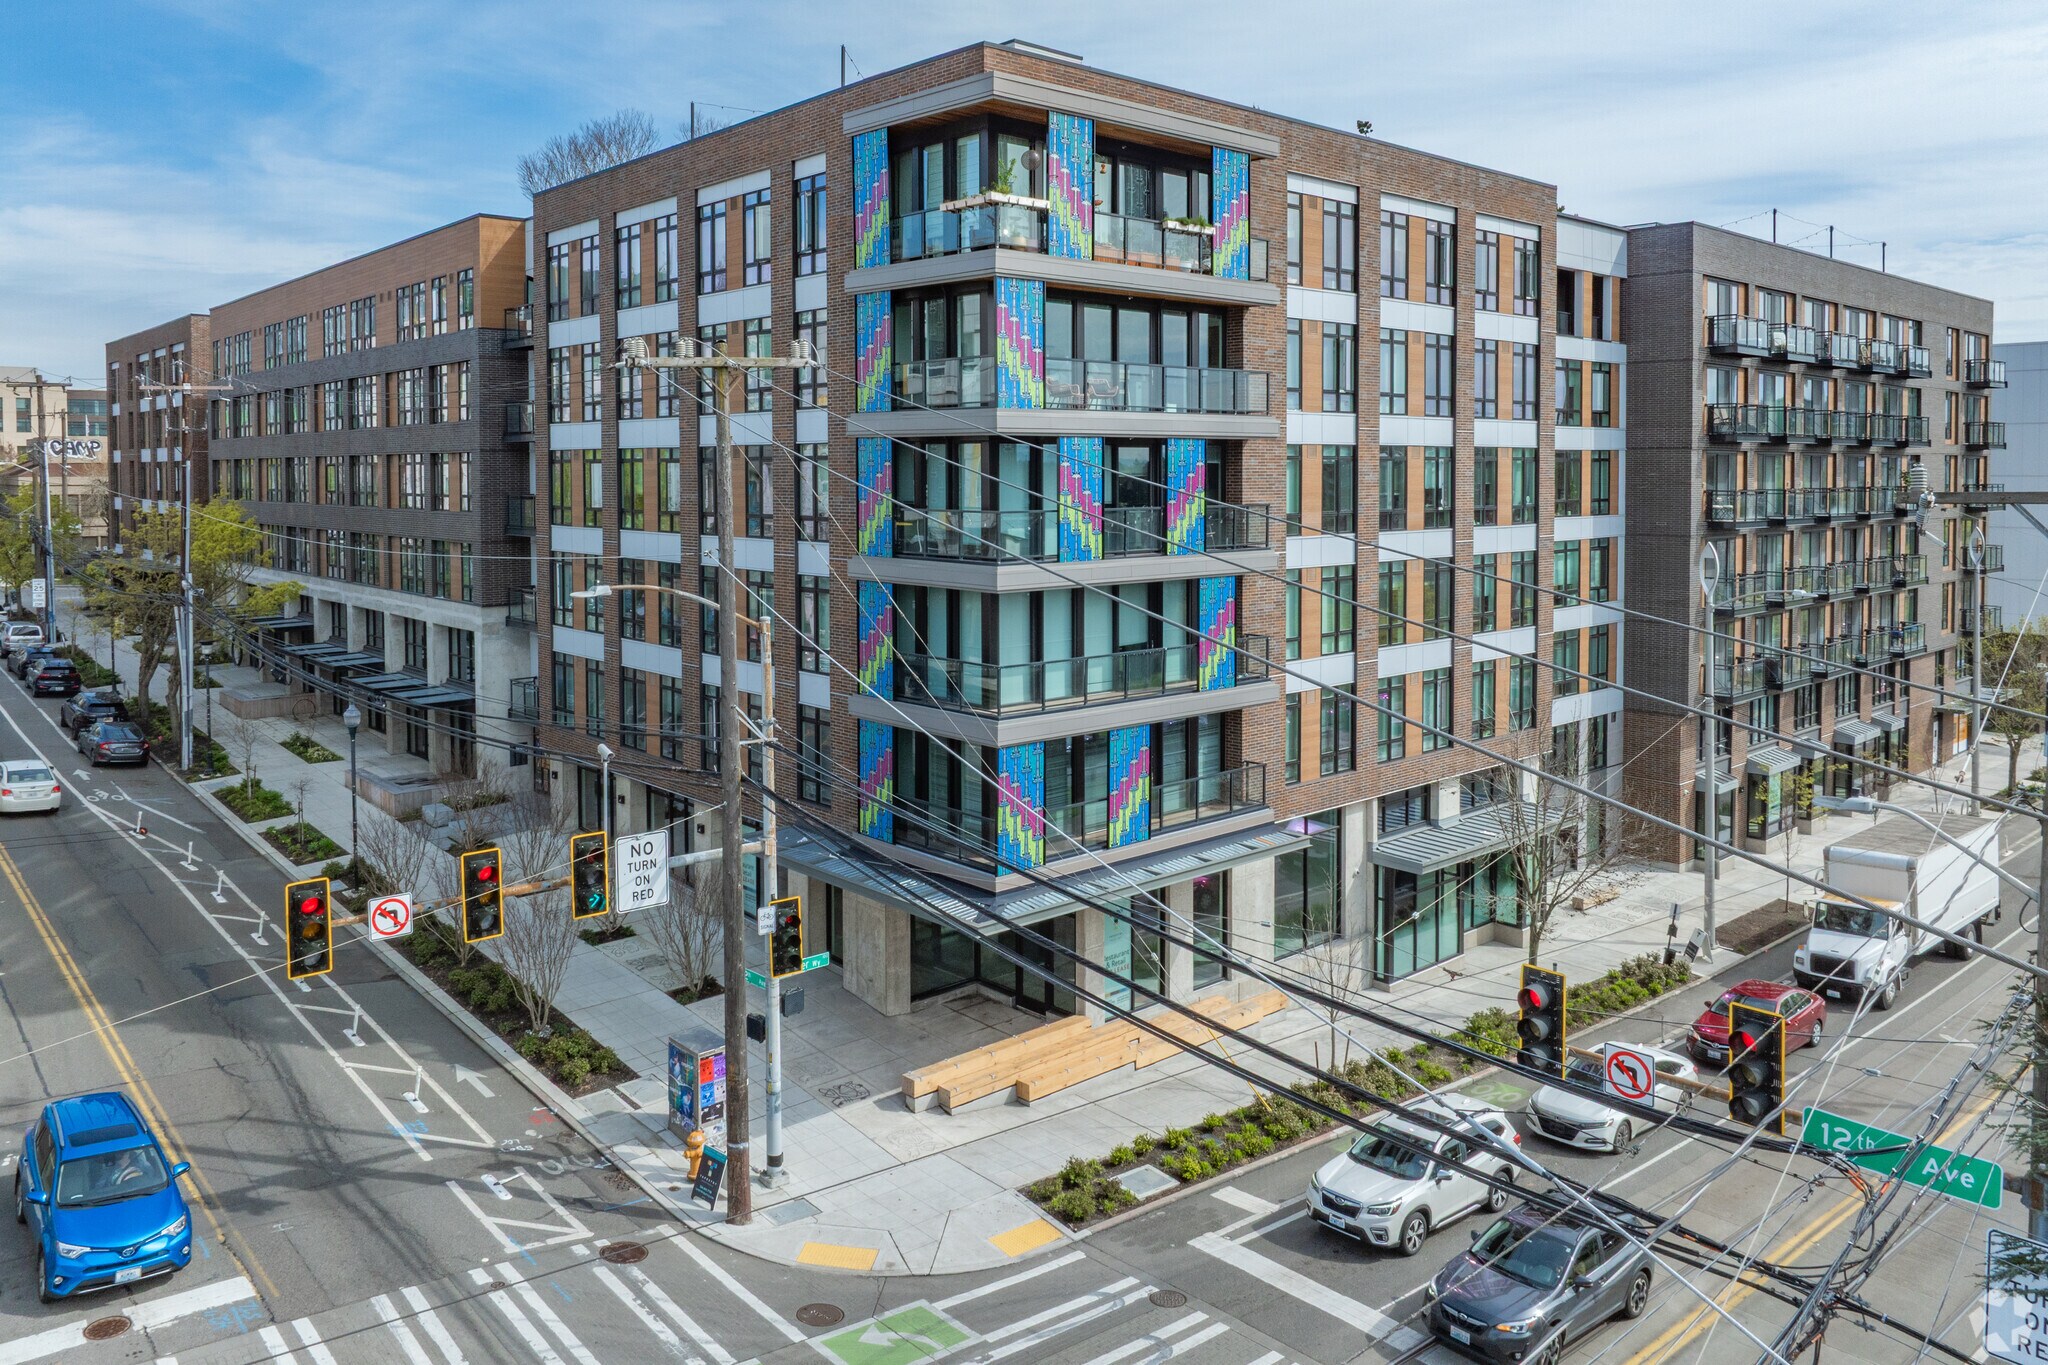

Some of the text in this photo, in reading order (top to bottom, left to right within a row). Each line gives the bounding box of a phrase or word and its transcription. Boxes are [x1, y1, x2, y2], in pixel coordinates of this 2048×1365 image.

[48, 438, 102, 460] CAMP
[630, 841, 654, 858] NO
[627, 858, 657, 873] TURN
[635, 874, 650, 887] ON
[632, 888, 654, 902] RED
[1820, 1122, 1976, 1189] 12th Ave
[2018, 1333, 2048, 1361] RE
